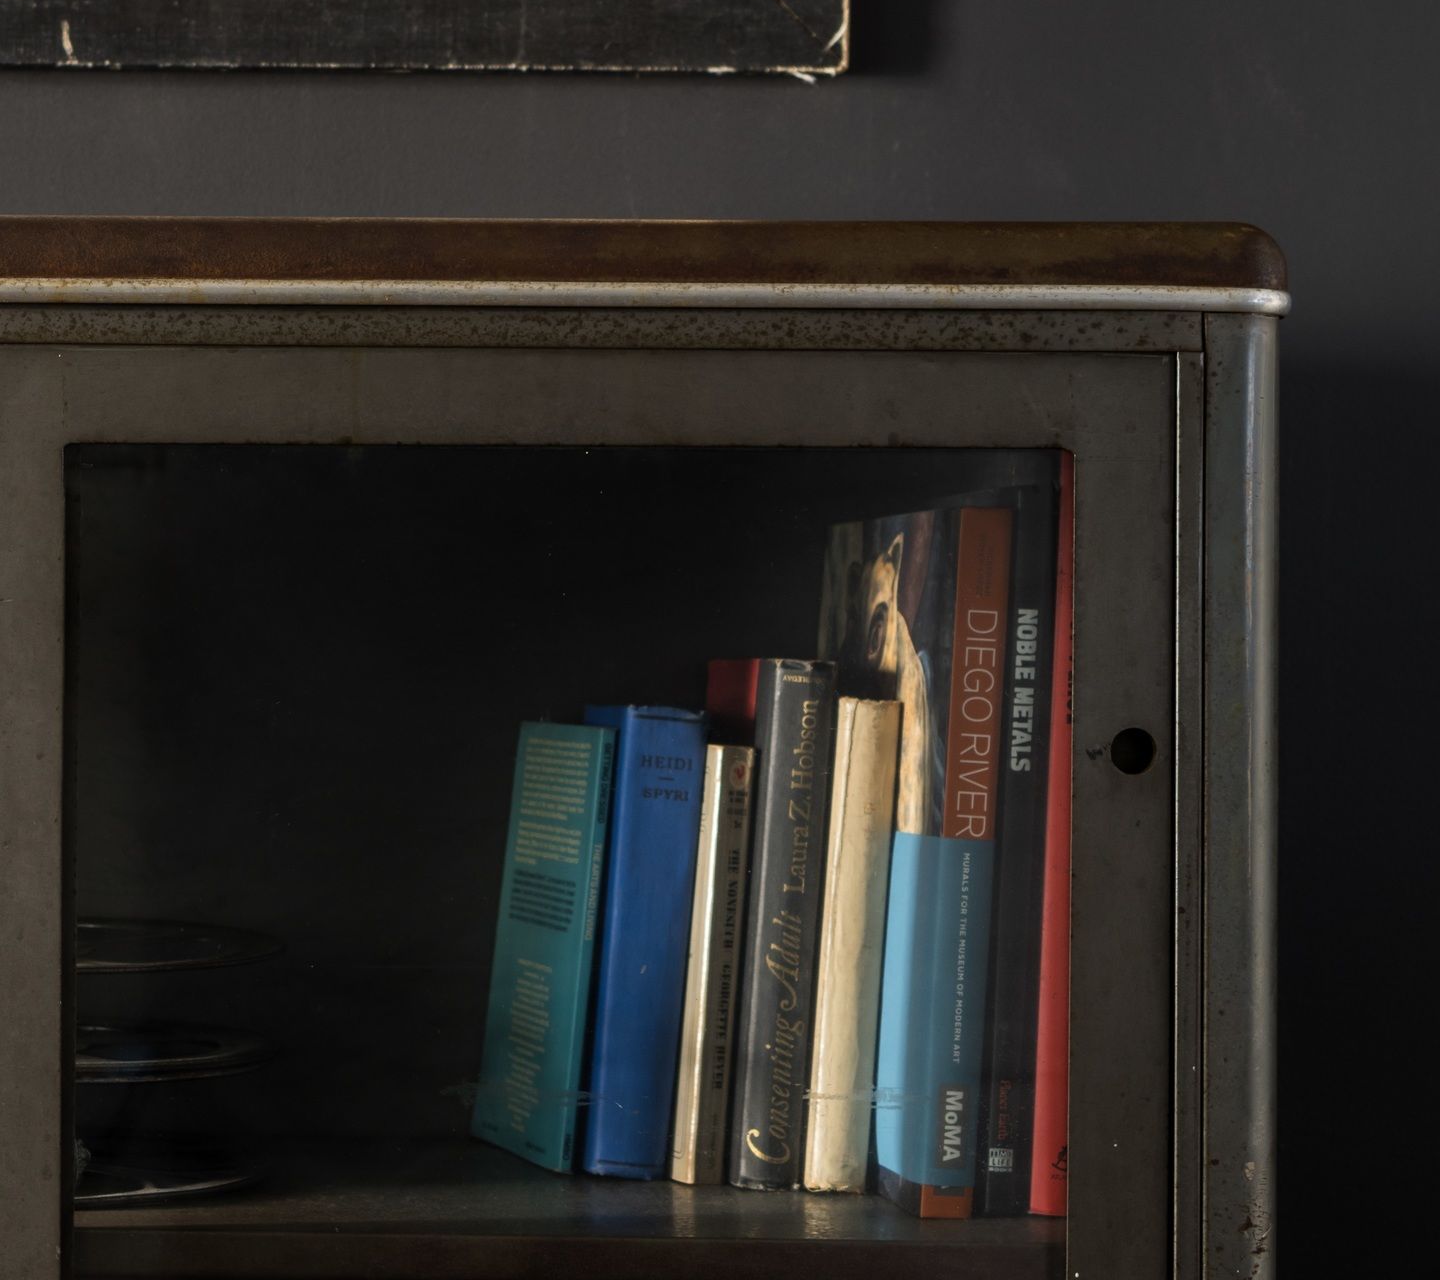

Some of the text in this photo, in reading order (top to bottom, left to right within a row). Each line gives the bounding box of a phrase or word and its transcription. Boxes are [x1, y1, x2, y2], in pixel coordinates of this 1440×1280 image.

[961, 608, 998, 723] DIEGO
[1010, 608, 1039, 773] NOBLE METALS
[641, 754, 694, 772] HEIDI
[790, 699, 820, 791] Hobson
[641, 787, 690, 803] SPYRI
[783, 825, 809, 894] Laura
[764, 910, 803, 1012] Adult
[952, 852, 971, 1064] MURALS FOR THE MUSEUM OF MODERN ART
[746, 1012, 804, 1164] Consenting
[941, 1089, 964, 1163] MoMA
